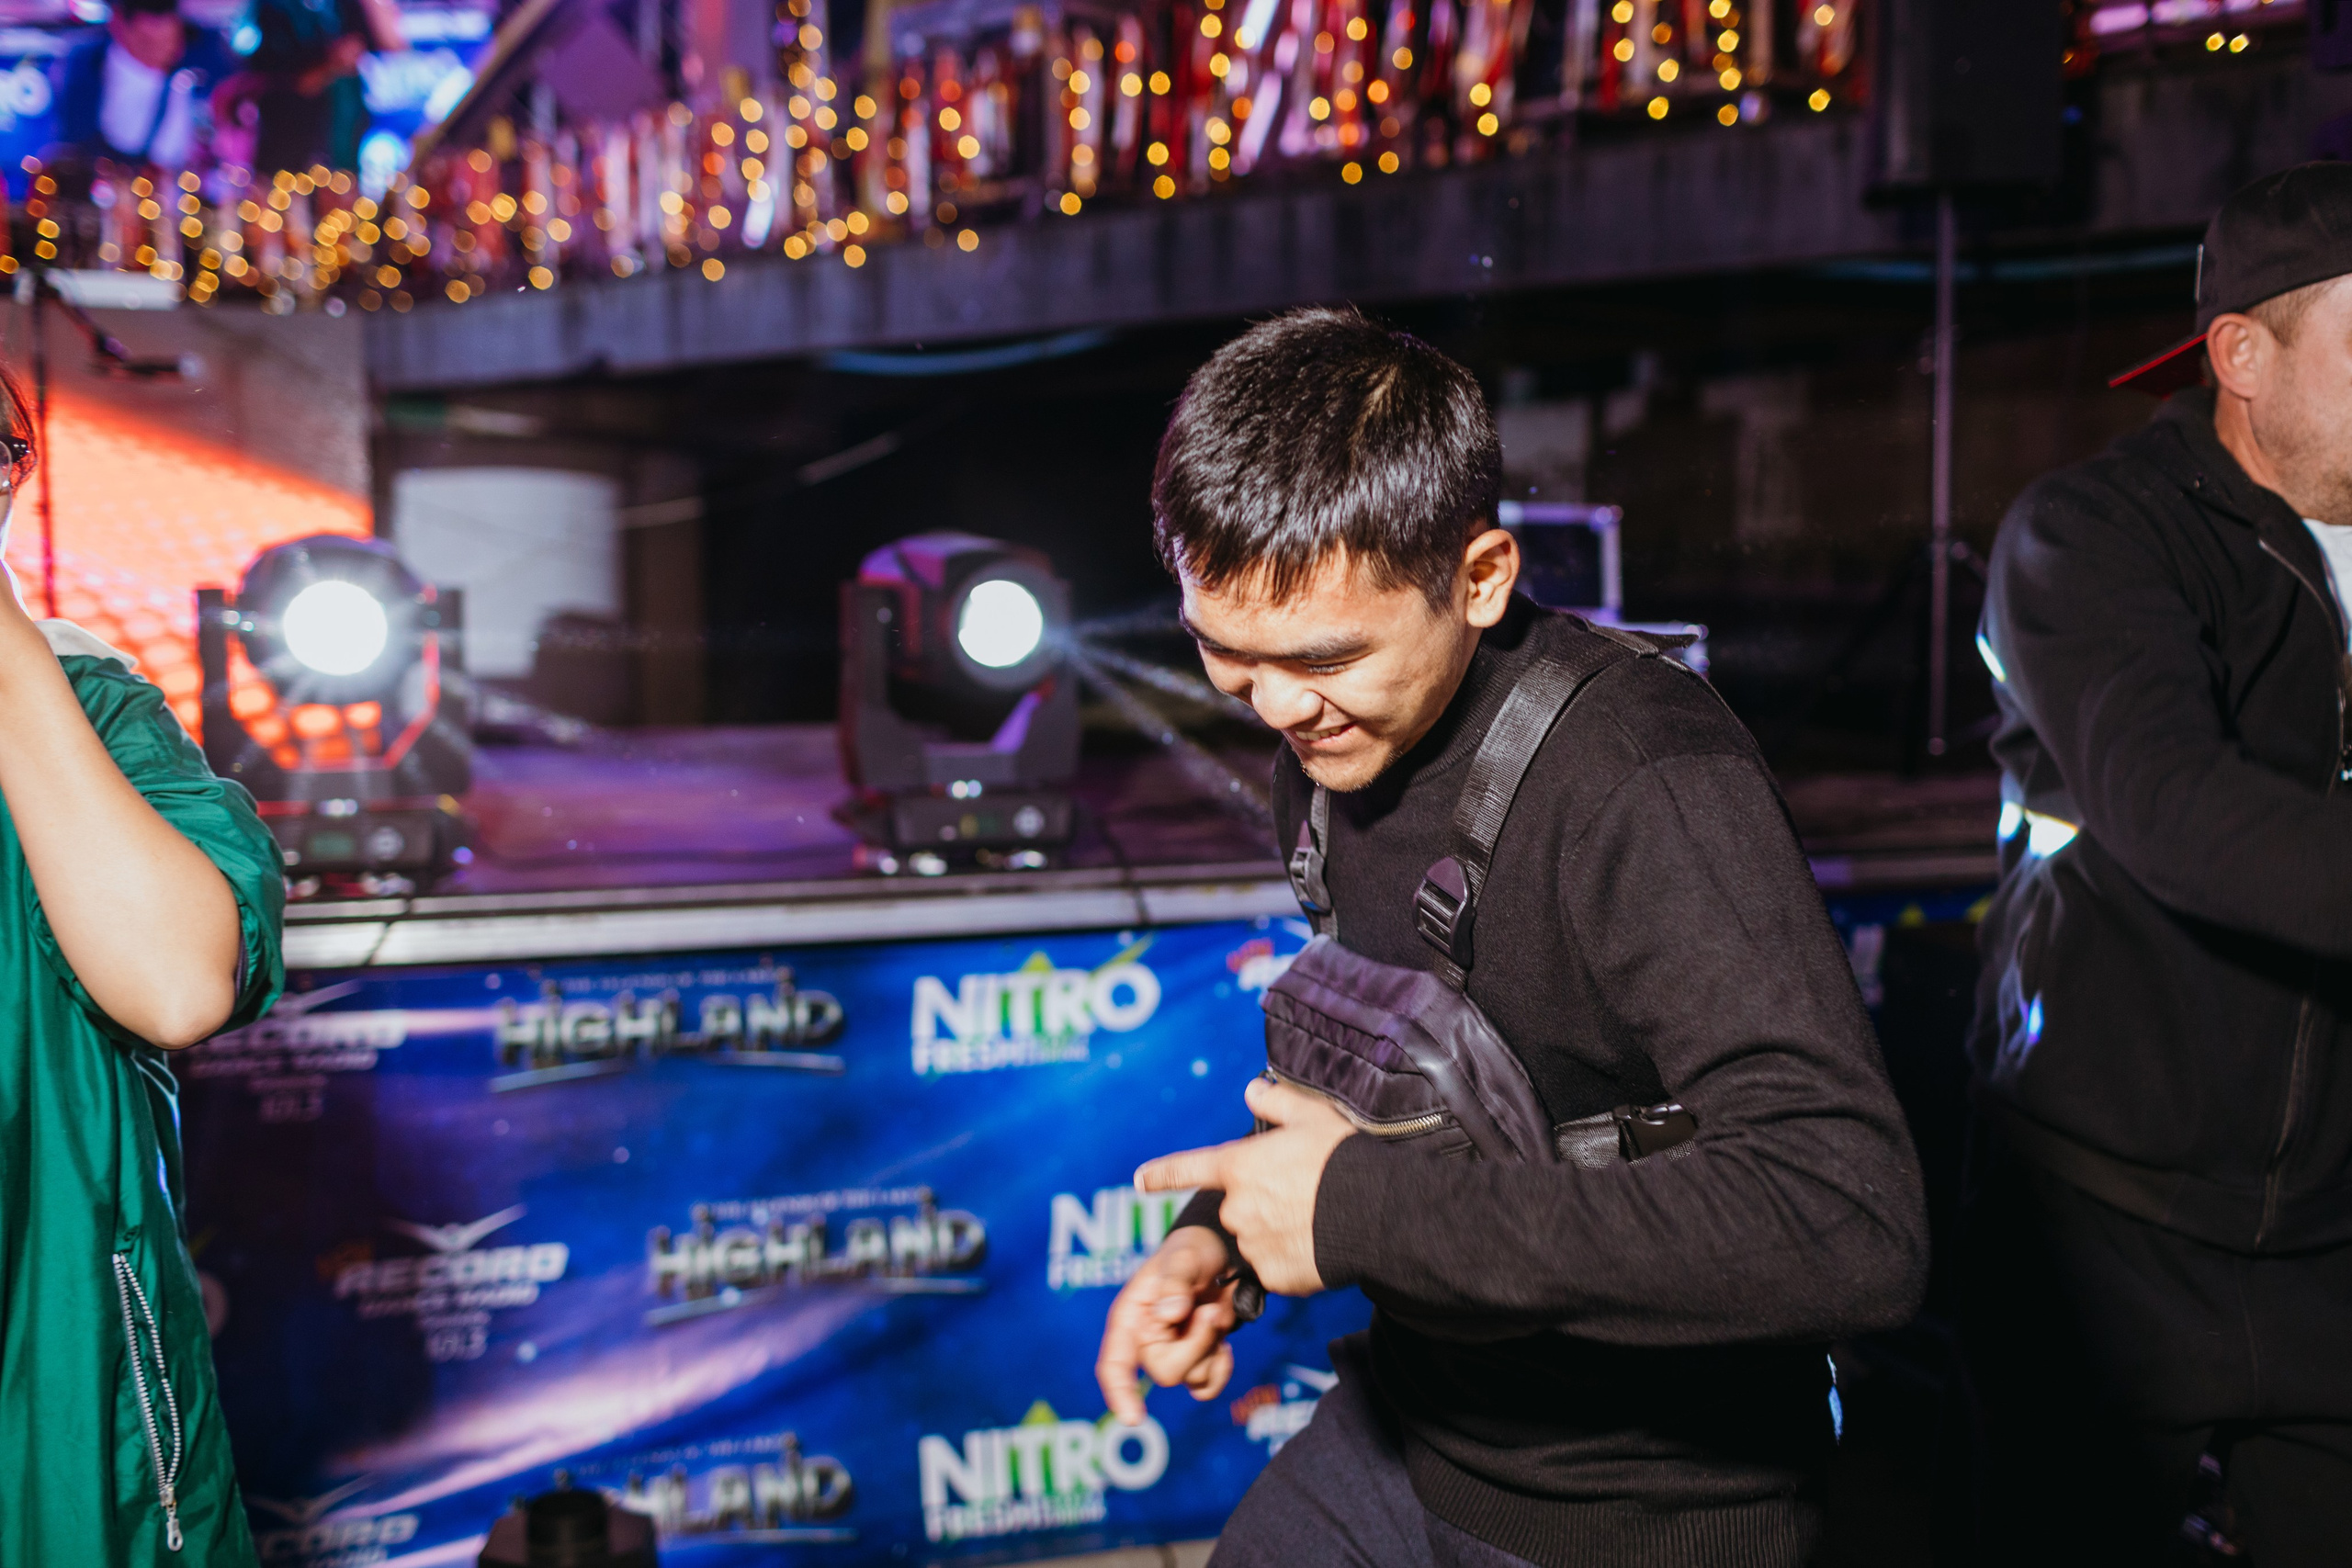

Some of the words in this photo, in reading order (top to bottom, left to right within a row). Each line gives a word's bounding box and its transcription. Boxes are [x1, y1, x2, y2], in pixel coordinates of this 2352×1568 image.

[191, 1009, 408, 1055] ECORD
[495, 976, 844, 1066] HIGHLAND
[911, 957, 1162, 1042] NITRO
[647, 1208, 988, 1293] HIGHLAND
[1049, 1185, 1200, 1253] NIT
[334, 1241, 570, 1300] RECORD
[919, 1413, 1170, 1514] NITRO
